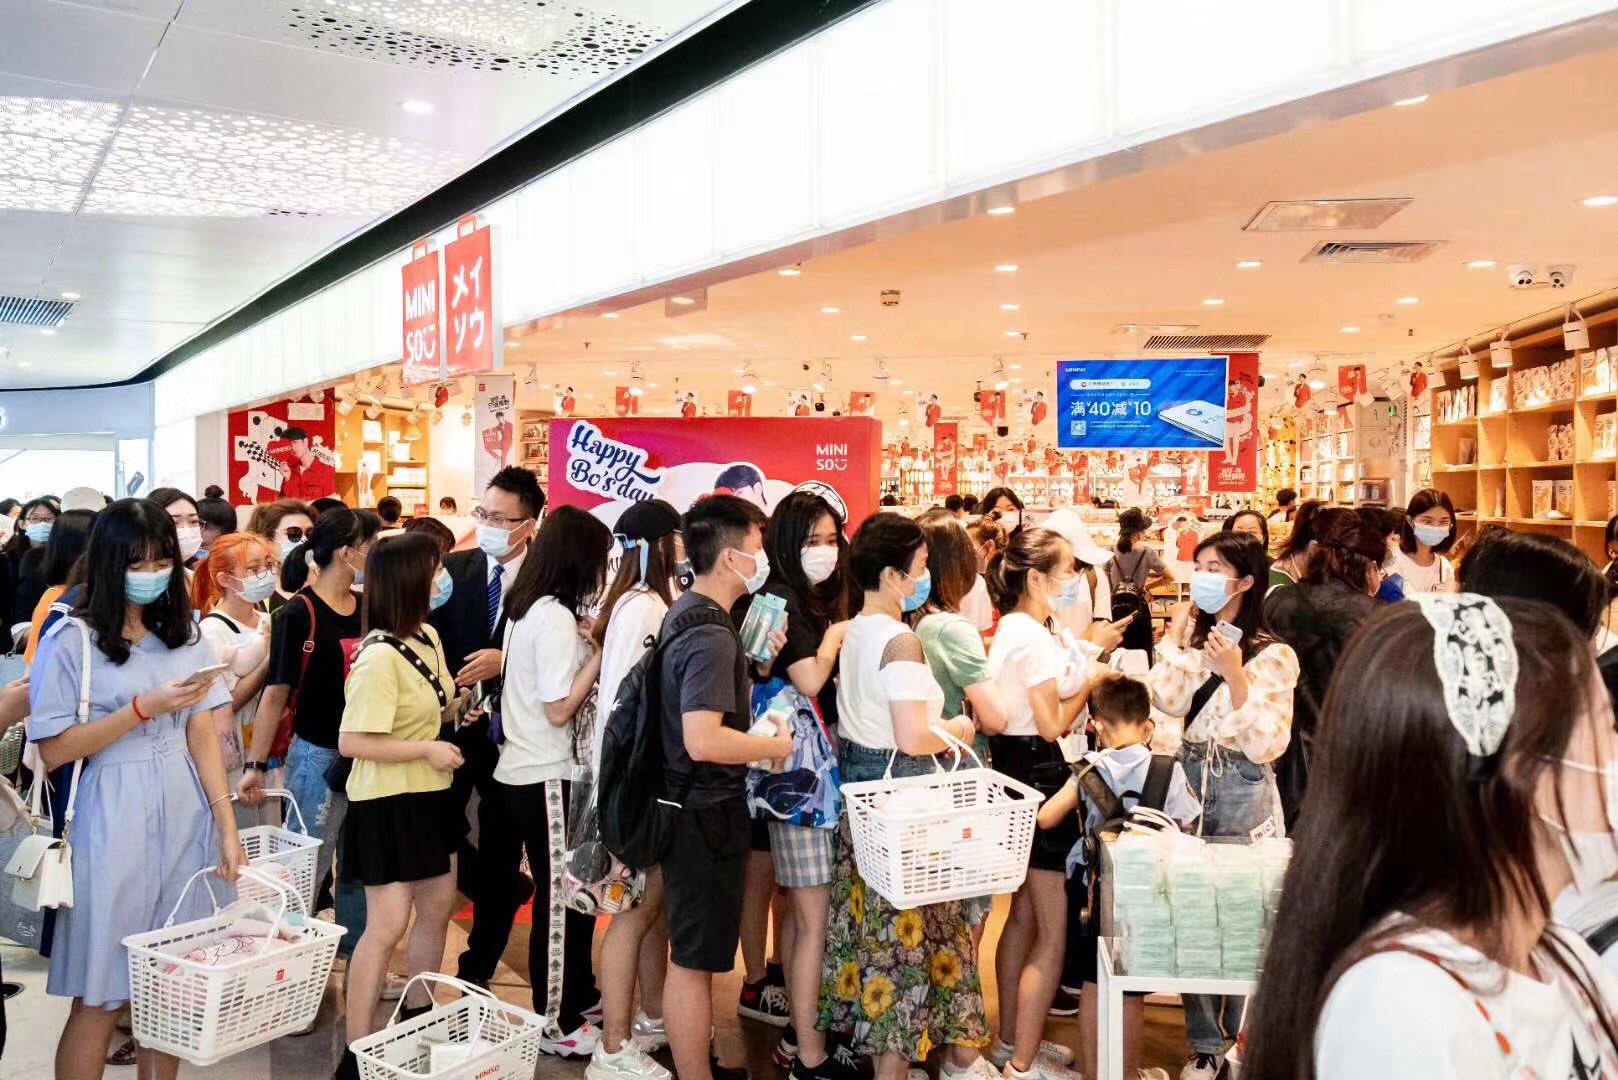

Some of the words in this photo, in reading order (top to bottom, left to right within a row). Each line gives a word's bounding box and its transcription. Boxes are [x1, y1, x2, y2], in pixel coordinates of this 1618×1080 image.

[405, 279, 436, 321] MINI
[451, 255, 483, 309] メイ
[453, 307, 485, 354] ソウ
[571, 424, 661, 485] Happy
[815, 443, 848, 456] MINI
[570, 458, 617, 492] Bo's
